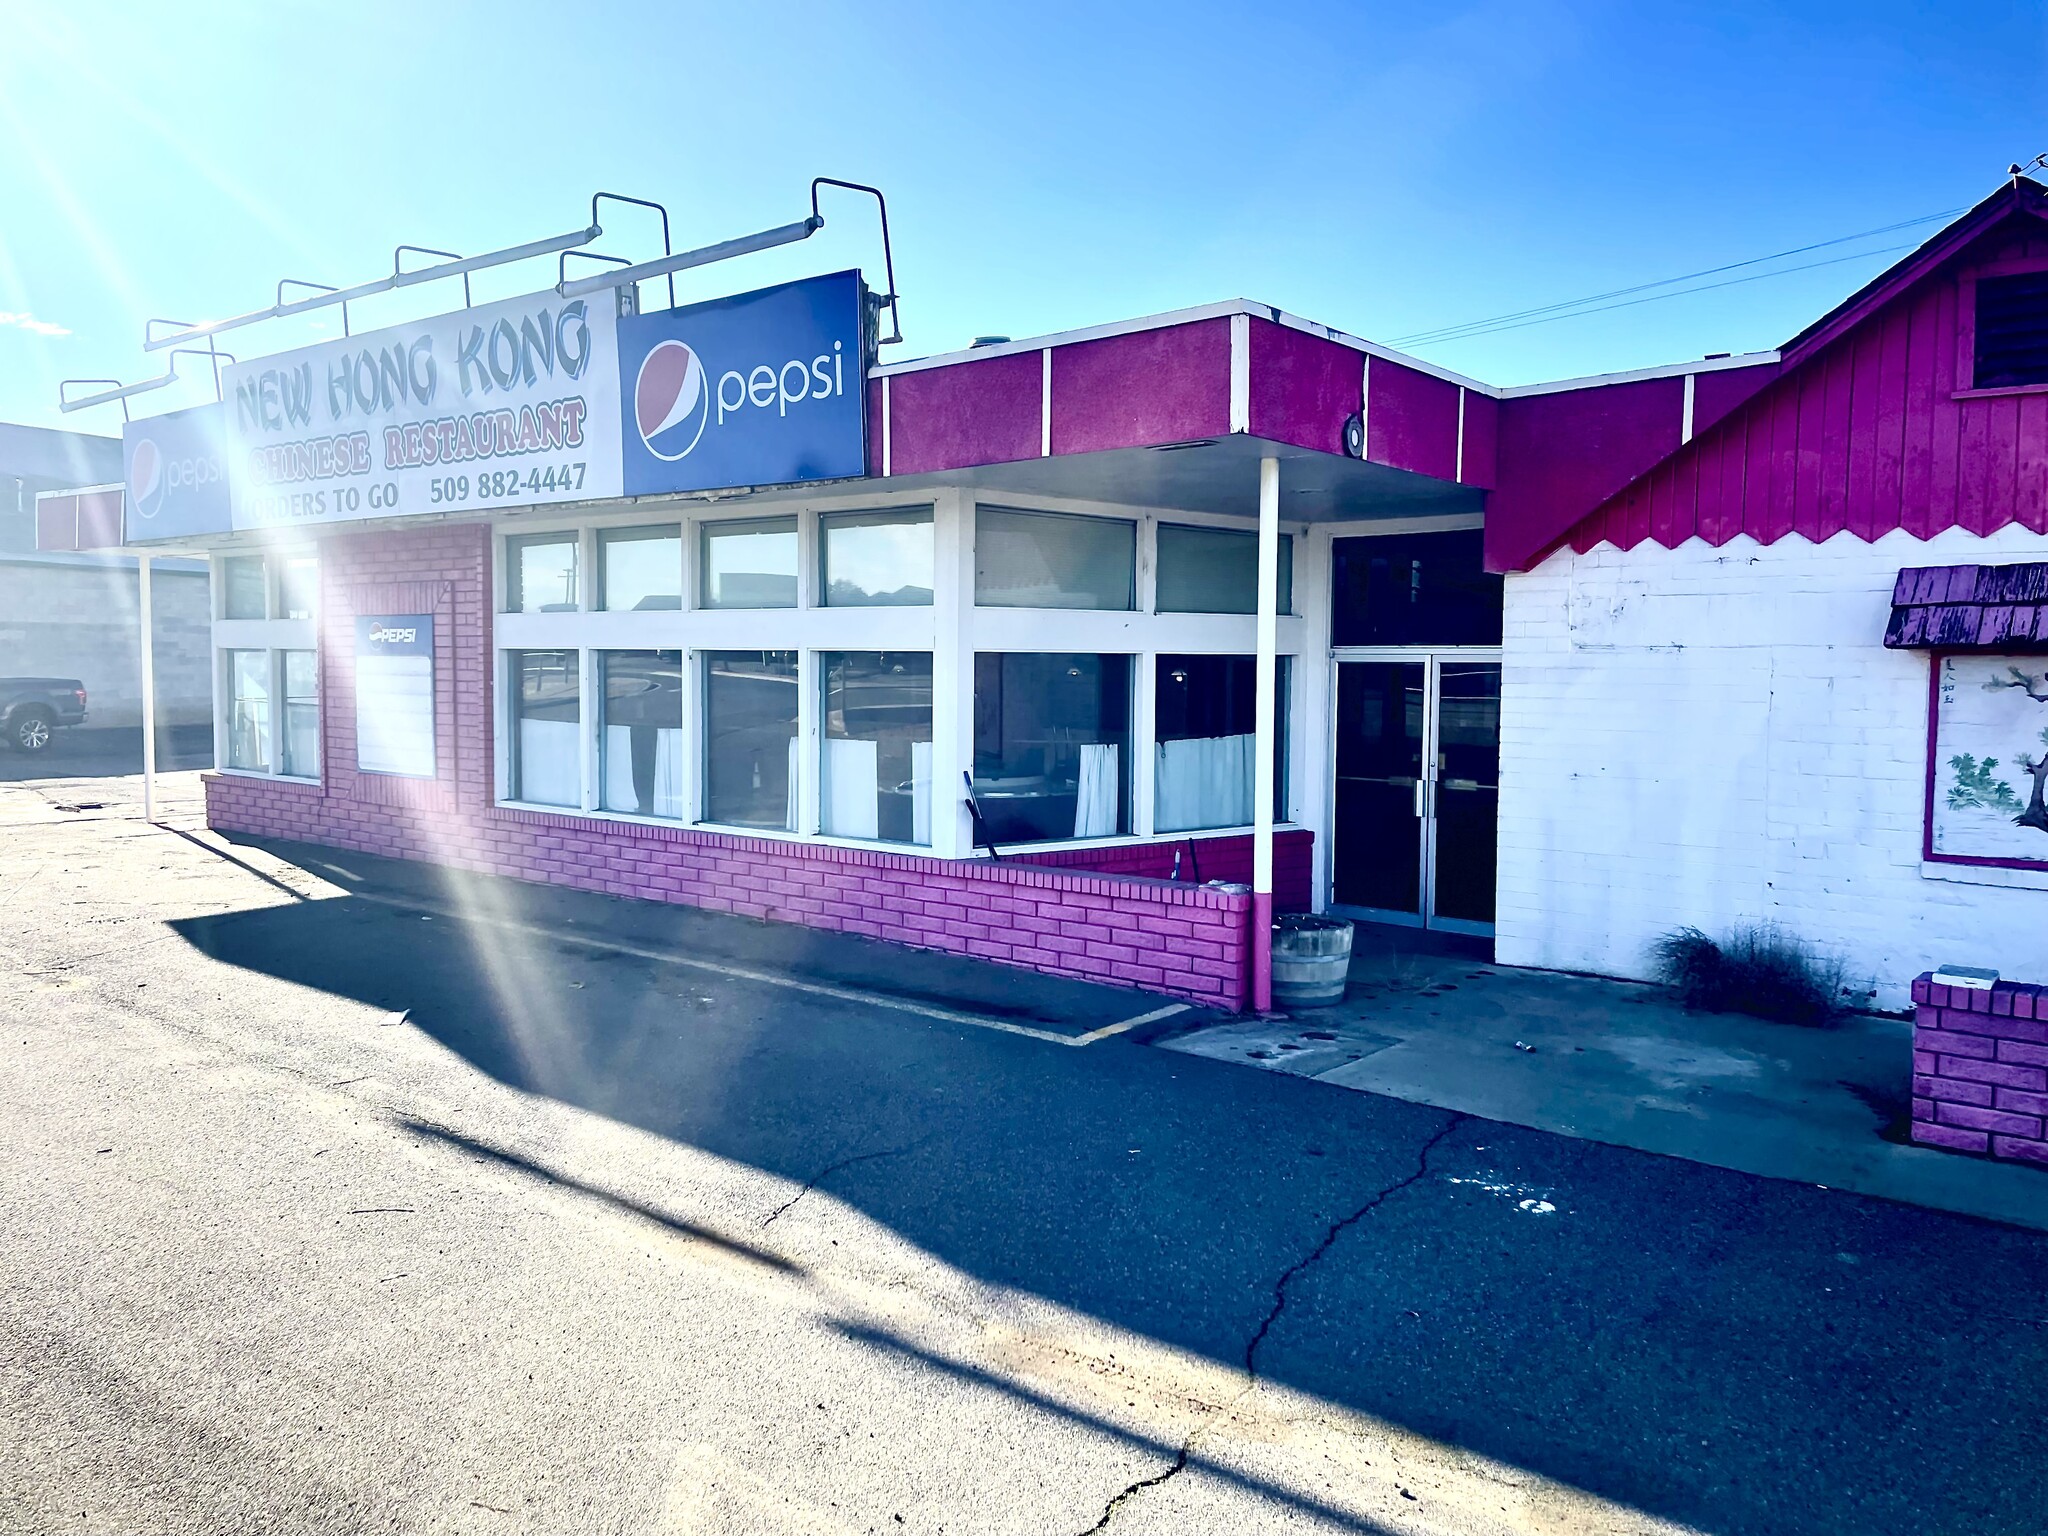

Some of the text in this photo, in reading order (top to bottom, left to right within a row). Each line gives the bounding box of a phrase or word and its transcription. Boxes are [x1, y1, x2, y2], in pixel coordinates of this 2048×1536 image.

[235, 300, 592, 433] NEW HONG KONG
[717, 340, 843, 426] pepsi
[249, 395, 587, 487] CHINESE RESTAURANT
[167, 452, 224, 496] pepsi
[430, 462, 587, 504] 509 882-4447
[252, 482, 399, 520] ORDERS TO GO
[381, 628, 417, 643] PEPSI
